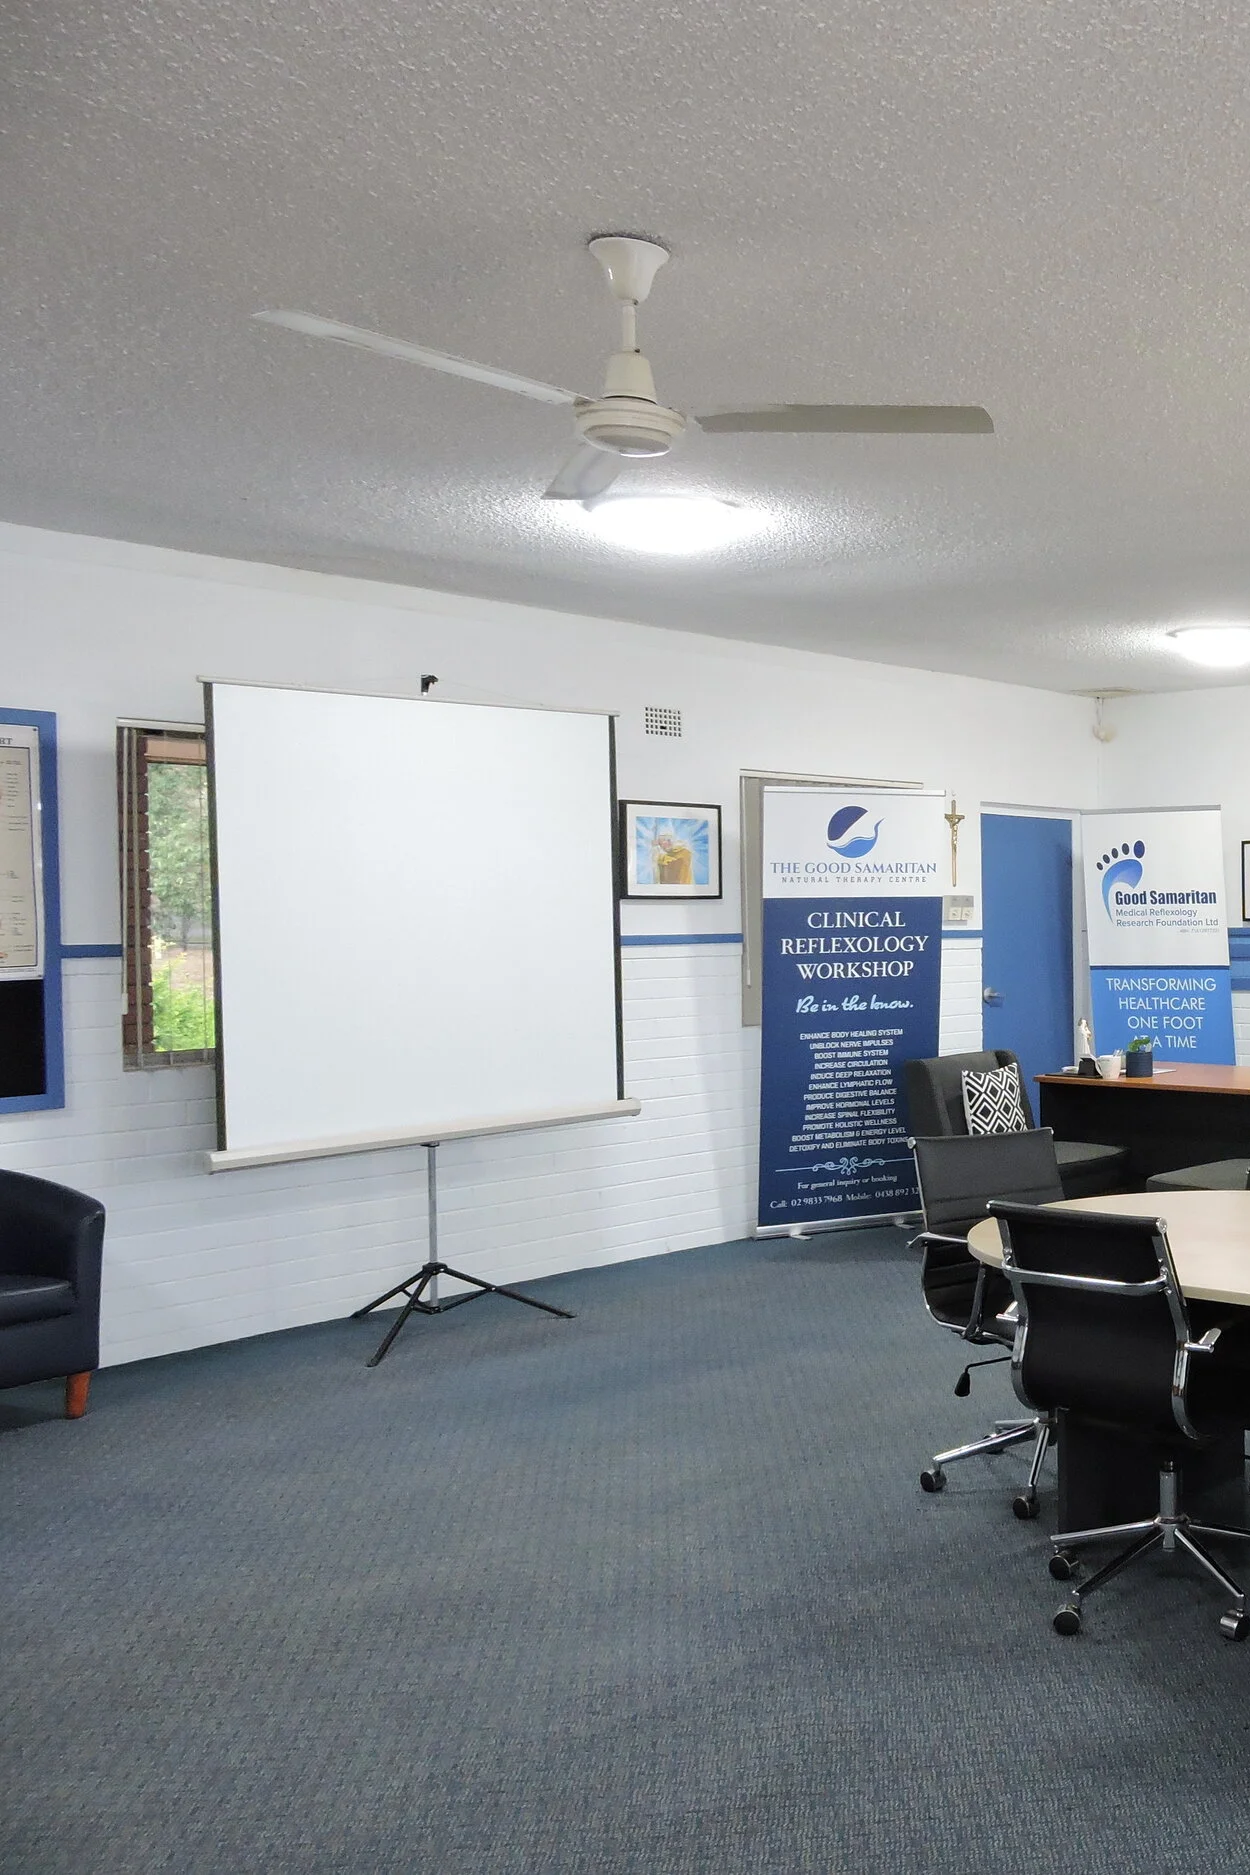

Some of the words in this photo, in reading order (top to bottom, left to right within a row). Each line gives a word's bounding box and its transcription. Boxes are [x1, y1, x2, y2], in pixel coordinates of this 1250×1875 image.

[770, 862, 801, 874] THE
[804, 862, 851, 874] GOOD
[855, 862, 937, 874] SAMARITAN
[1115, 890, 1148, 905] Good
[1150, 889, 1217, 905] Samaritan
[807, 911, 906, 928] CLINICAL
[1115, 909, 1148, 917] Medical
[1149, 908, 1198, 918] Reflexology
[1116, 919, 1154, 927] Research
[1205, 918, 1219, 926] Ltd
[781, 935, 929, 955] REFLEXOLOGY
[796, 960, 914, 980] WORKSHOP
[1105, 977, 1217, 991] TRANSFORMING
[795, 995, 821, 1014] Be
[821, 999, 839, 1011] in
[840, 994, 868, 1012] the
[869, 993, 914, 1010] know.
[1119, 997, 1206, 1011] HEALTHCARE
[1127, 1016, 1159, 1030] ONE
[1163, 1015, 1204, 1030] FOOT
[800, 1032, 831, 1040] ENHANCE
[831, 1031, 850, 1039] BODY
[850, 1029, 877, 1038] HEALING
[878, 1028, 903, 1036] SYSTEM
[810, 1041, 840, 1050] UNBLOCK
[841, 1040, 862, 1048] NERVE
[862, 1039, 894, 1047] IMPULSES
[1152, 1035, 1163, 1049] A
[1165, 1035, 1197, 1049] TIME
[814, 1052, 836, 1060] BOOST
[863, 1049, 889, 1057] SYSTEM
[814, 1061, 846, 1070] INCREASE
[847, 1058, 889, 1068] CIRCULATION
[810, 1072, 834, 1080] INDUCE
[835, 1071, 853, 1079] DEEP
[853, 1069, 892, 1077] RELAXATION
[809, 1081, 838, 1091] ENHANCE
[840, 1080, 874, 1089] LYMPHATIC
[875, 1078, 894, 1086] FLOW
[803, 1092, 834, 1100] PRODUCE
[835, 1090, 868, 1099] DIGESTIVE
[868, 1088, 898, 1096] BALANCE
[806, 1102, 834, 1111] IMPROVE
[835, 1100, 870, 1108] HORMONAL
[871, 1098, 895, 1106] LEVELS
[805, 1111, 836, 1121] INCREASE
[860, 1108, 895, 1116] FLEXIBILITY
[802, 1122, 833, 1131] PROMOTE
[834, 1120, 863, 1129] HOLISTIC
[864, 1118, 898, 1126] WELLNESS
[791, 1133, 814, 1142] BOOST
[815, 1130, 855, 1139] METABOLISM
[861, 1128, 887, 1136] ENERGY
[888, 1126, 906, 1134] LEVEL
[789, 1143, 821, 1152] DETOXIFY
[821, 1142, 835, 1150] AND
[835, 1140, 867, 1149] ELIMINATE
[868, 1138, 886, 1146] BODY
[797, 1181, 809, 1189] For
[810, 1179, 836, 1190] general
[837, 1178, 861, 1188] inquiry
[871, 1174, 898, 1183] booking
[770, 1200, 788, 1209] Call:
[791, 1198, 802, 1207] 02
[803, 1196, 823, 1205] 9833
[824, 1194, 843, 1203] 7968
[846, 1192, 871, 1201] Mobile:
[895, 1187, 909, 1196] 892
